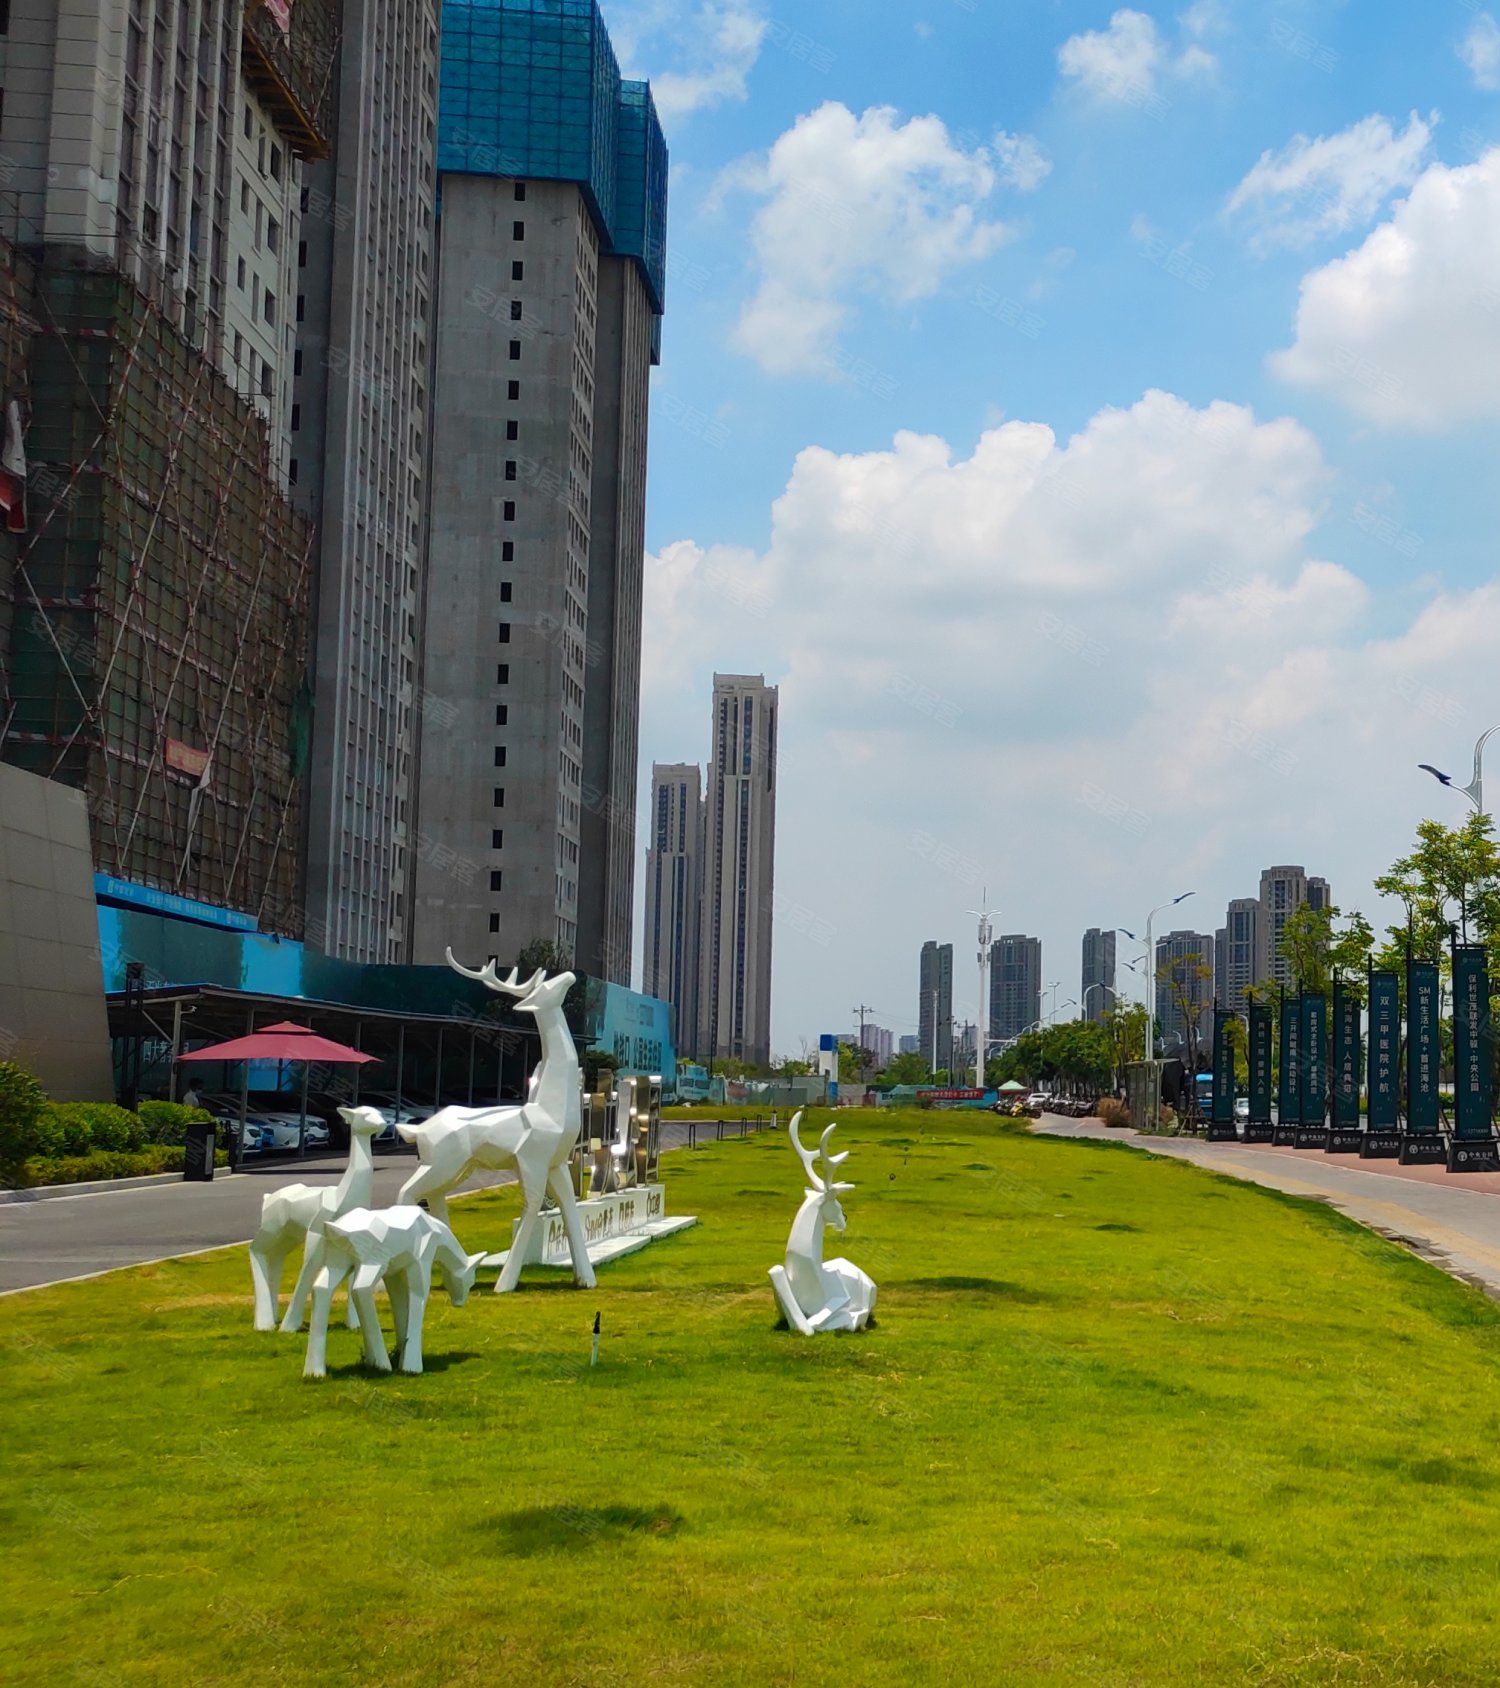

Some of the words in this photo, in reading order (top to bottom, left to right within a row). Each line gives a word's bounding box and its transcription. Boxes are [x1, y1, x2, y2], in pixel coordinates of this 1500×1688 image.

[1379, 996, 1389, 1093] 双三甲医院护航
